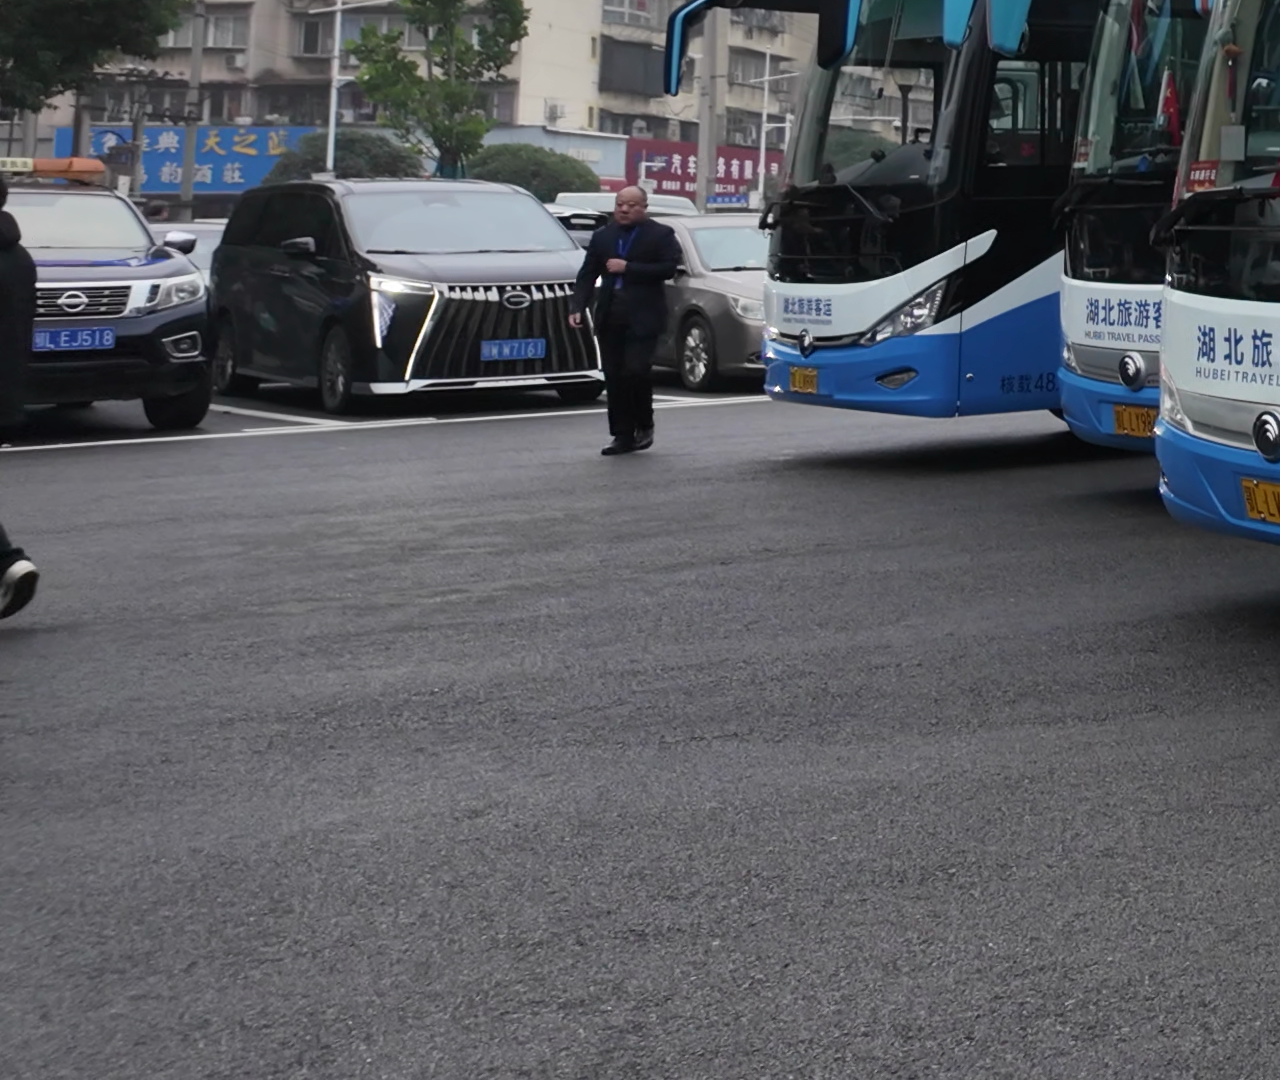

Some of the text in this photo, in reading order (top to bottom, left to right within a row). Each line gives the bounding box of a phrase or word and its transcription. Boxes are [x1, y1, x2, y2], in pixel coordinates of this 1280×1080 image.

[671, 153, 779, 180] 汽车务有限司
[1107, 331, 1136, 343] TRAVEL
[1001, 372, 1060, 393] 核载48
[1195, 367, 1231, 381] HUBEI
